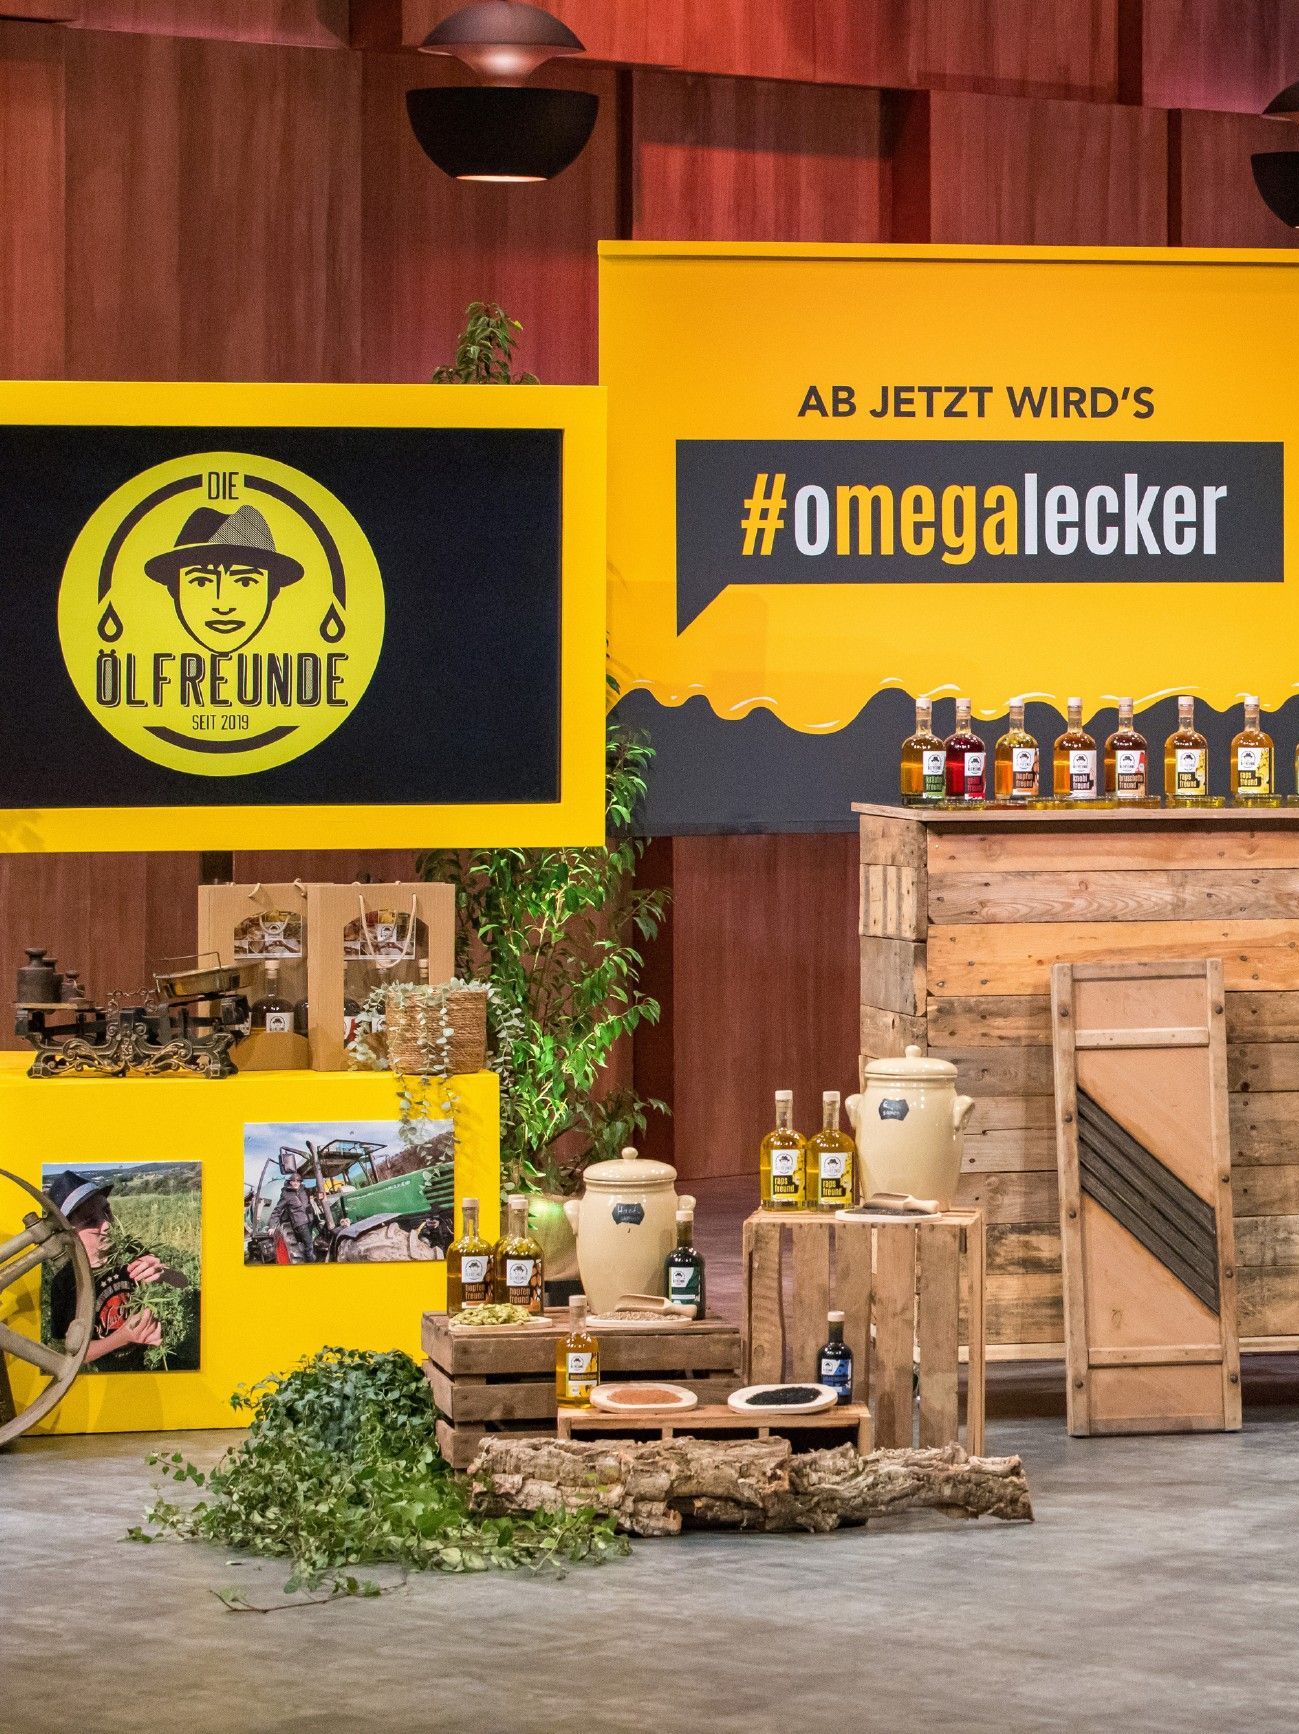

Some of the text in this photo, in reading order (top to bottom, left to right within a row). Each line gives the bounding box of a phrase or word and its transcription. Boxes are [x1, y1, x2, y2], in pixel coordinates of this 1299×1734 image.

[797, 385, 1156, 420] AB JETZT WIRD’S
[207, 471, 240, 501] DIE
[740, 472, 1228, 566] #omegalecker
[95, 648, 350, 708] ÖLFREUNDE
[191, 713, 250, 732] SEIT 2019
